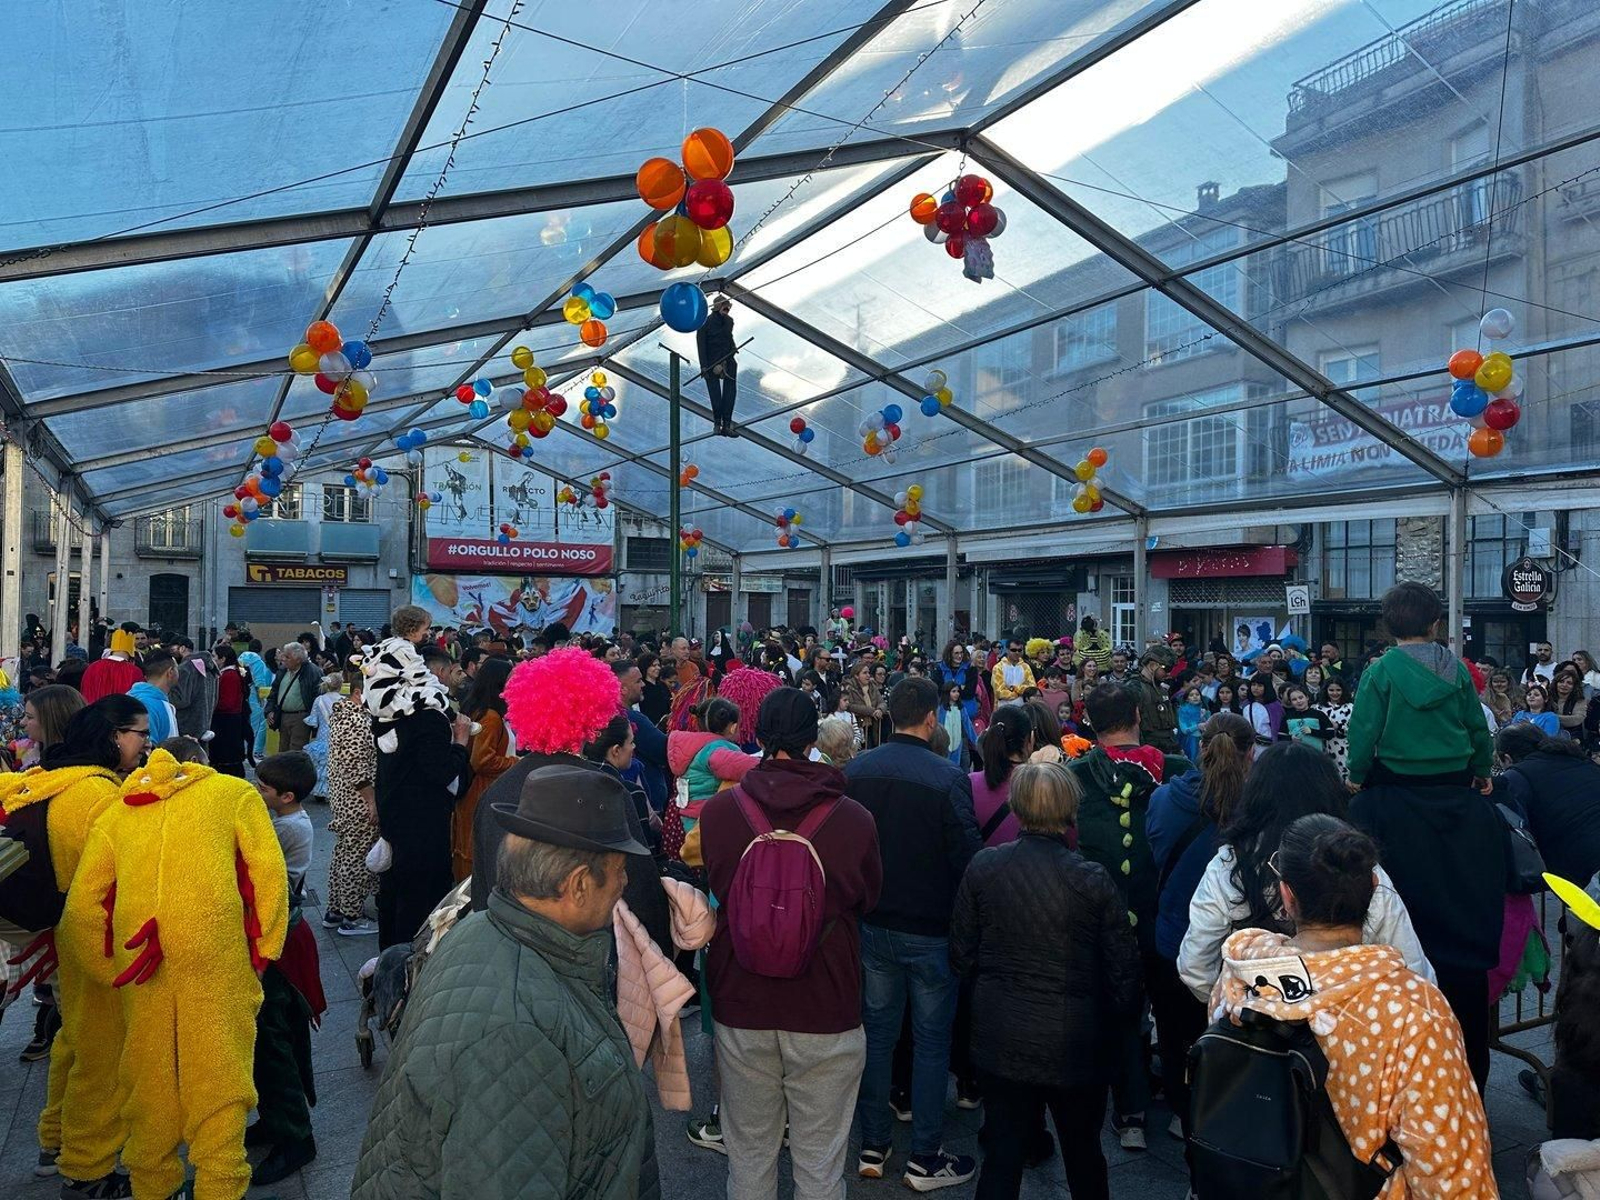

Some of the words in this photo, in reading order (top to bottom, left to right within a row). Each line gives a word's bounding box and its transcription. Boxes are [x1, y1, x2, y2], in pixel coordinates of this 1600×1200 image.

[1302, 453, 1346, 470] LIMIA
[1350, 443, 1391, 462] NON
[448, 544, 520, 558] #ORGULLO
[523, 547, 558, 559] POLO
[561, 548, 596, 560] NOSO
[276, 568, 345, 579] TABACOS
[1512, 570, 1542, 581] Estrella
[1513, 581, 1541, 592] Galicia
